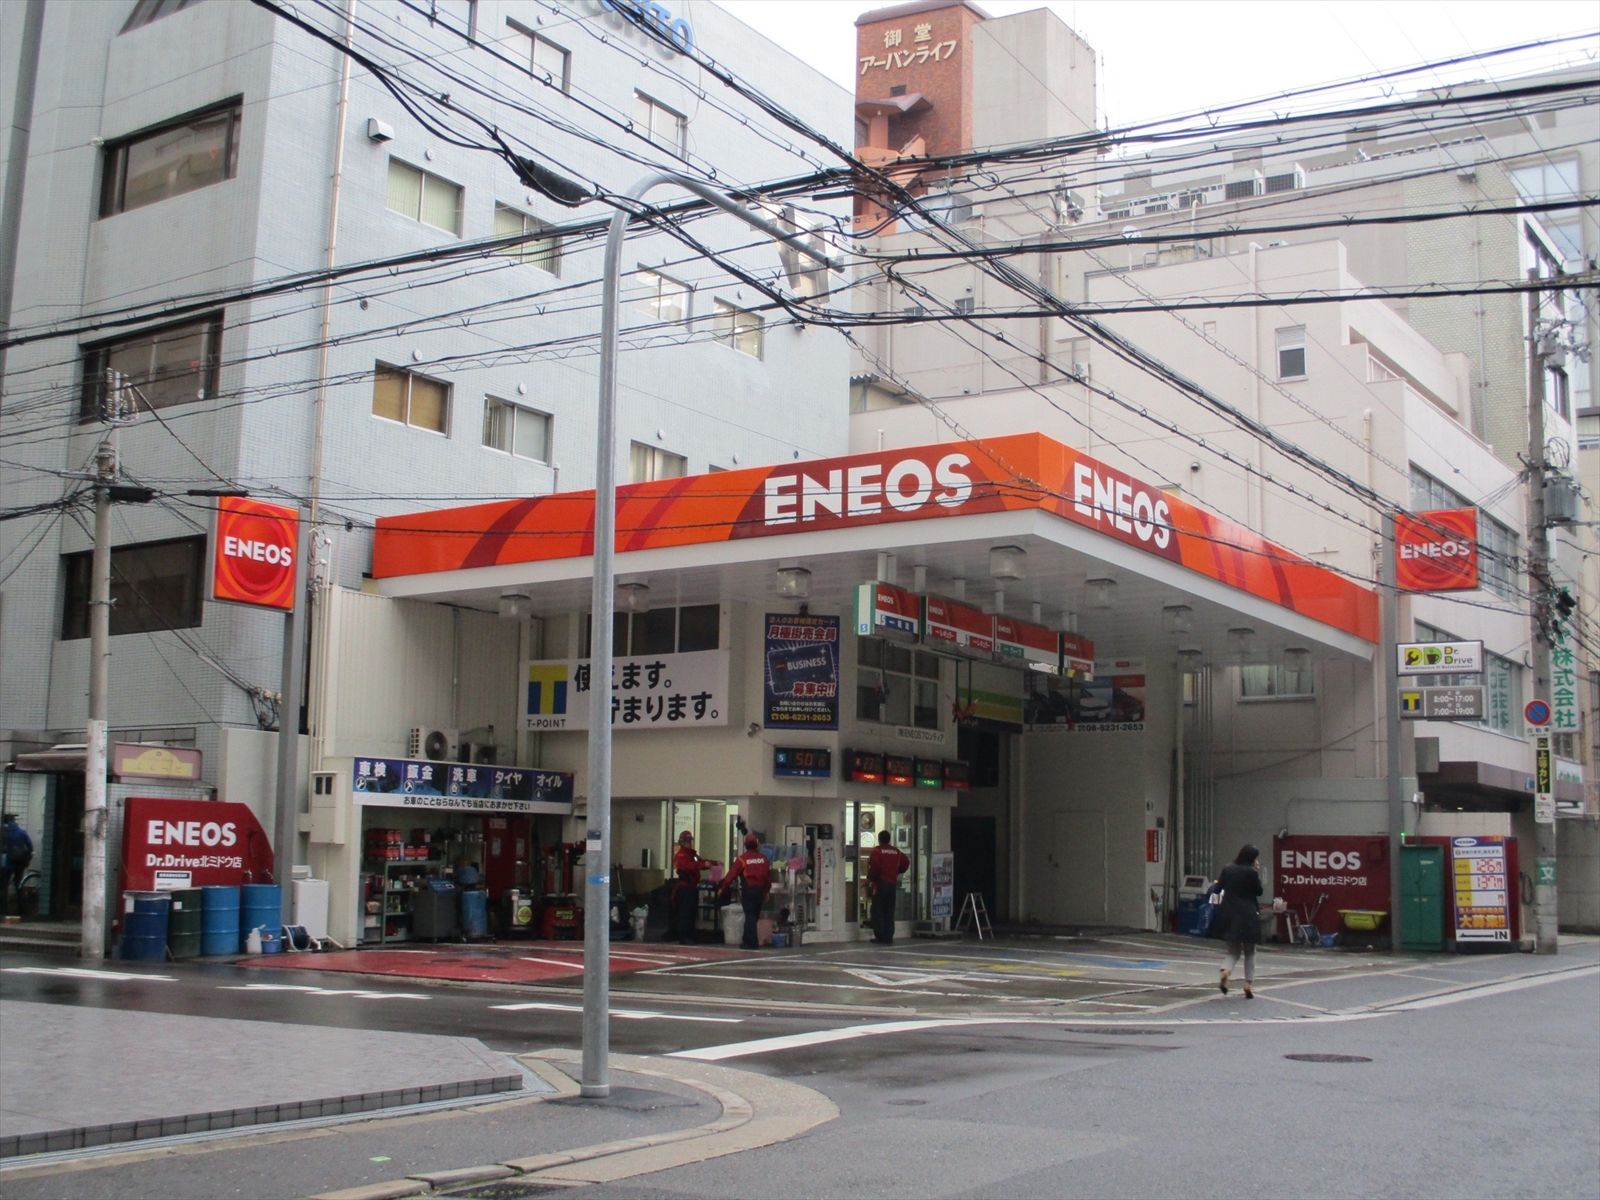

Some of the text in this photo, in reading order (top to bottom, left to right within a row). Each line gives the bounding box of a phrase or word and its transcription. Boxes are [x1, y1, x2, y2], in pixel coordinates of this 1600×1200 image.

[883, 22, 932, 49] 御堂
[859, 40, 957, 75] アーバンライフ
[764, 453, 973, 526] ENEOS
[1074, 461, 1170, 549] ENEOS
[224, 535, 292, 567] ENEOS
[786, 657, 826, 671] BUSINESS
[1444, 656, 1473, 665] Drive
[527, 718, 567, 728] T-POINT
[358, 760, 387, 777] 車検
[452, 767, 478, 783] 洗車
[494, 772, 523, 786] タイヤ
[536, 774, 563, 788] オイル
[148, 819, 237, 847] ENEOS
[146, 853, 243, 868] Dr.Drive北ミドウ店
[1281, 850, 1361, 871] ENEOS
[1494, 930, 1508, 940] IN
